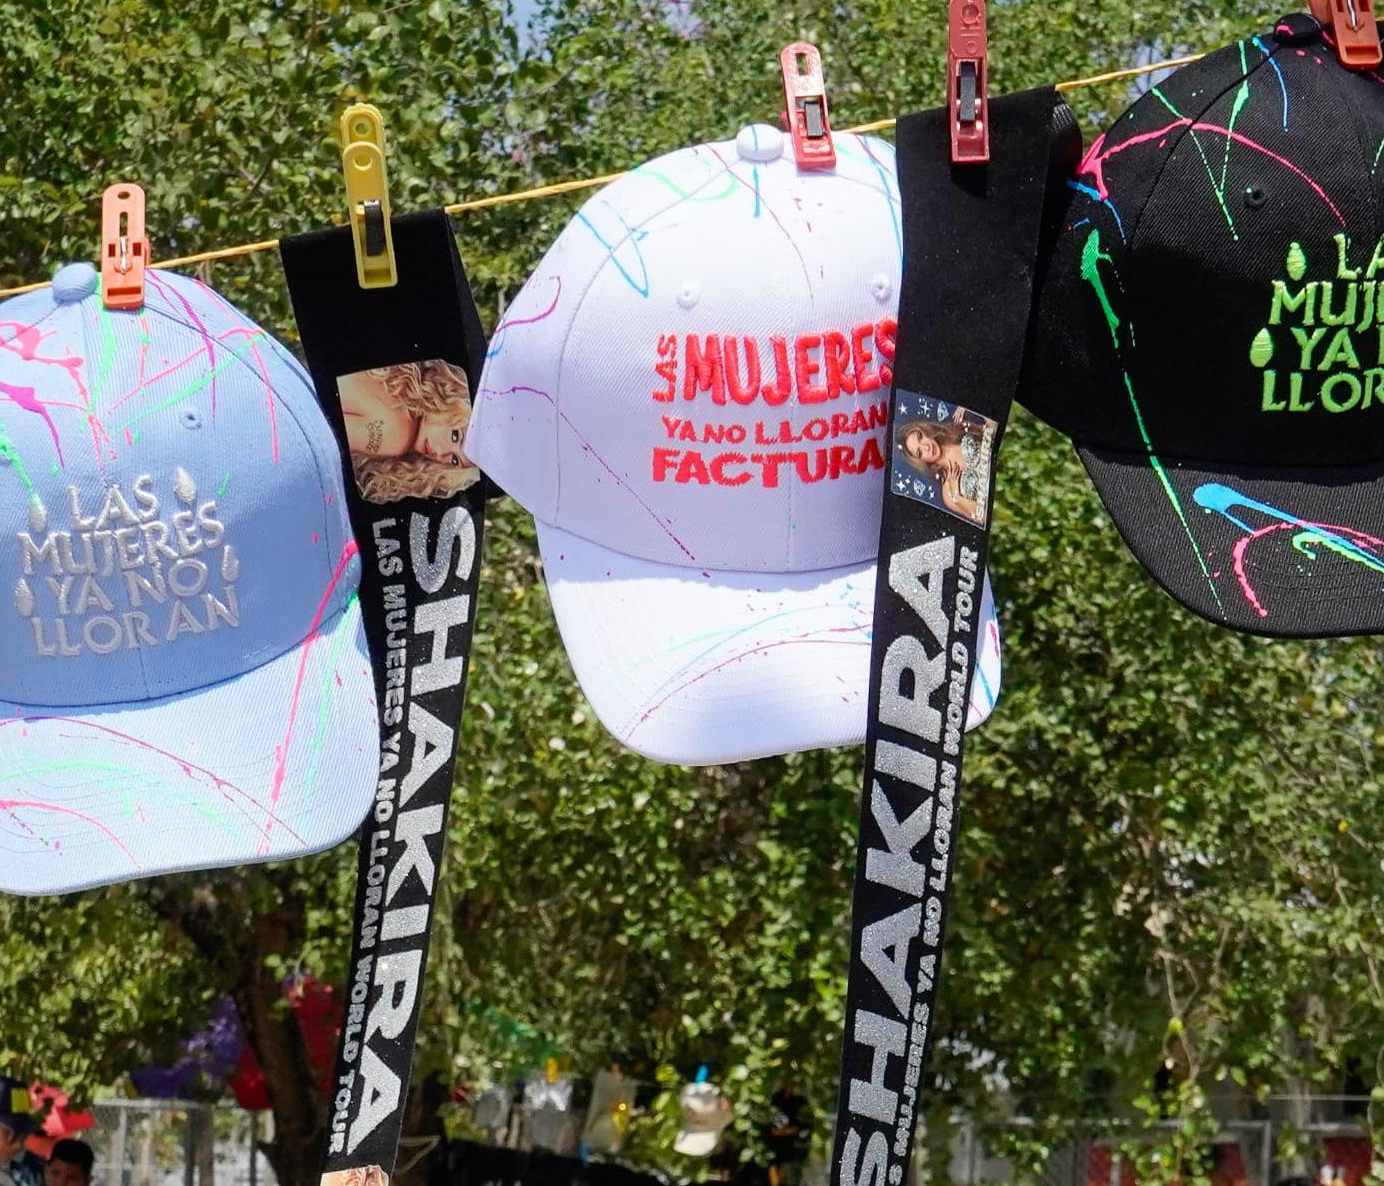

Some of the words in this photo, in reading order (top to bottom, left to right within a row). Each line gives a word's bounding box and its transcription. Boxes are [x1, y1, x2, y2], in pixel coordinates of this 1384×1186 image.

[650, 332, 678, 404] LAS
[682, 314, 899, 406] MUJERES
[1290, 326, 1361, 372] YA
[661, 413, 697, 443] YA
[703, 423, 747, 445] NO
[754, 400, 888, 446] LLORAN
[16, 500, 225, 577] MUJERES
[67, 473, 161, 530] LAS
[372, 517, 405, 578] LAS
[30, 584, 240, 657] LLORAN
[46, 575, 114, 615] YA
[123, 557, 208, 607] NO
[953, 545, 979, 633] TOUR
[382, 583, 408, 728] MUJERES
[943, 640, 969, 757] WORLD
[379, 731, 402, 773] YA
[346, 505, 476, 1156] SHAKIRA
[374, 777, 398, 824] NO
[929, 760, 957, 892] LLORAN
[359, 829, 391, 951] LLORAN
[923, 895, 942, 947] NO
[342, 953, 376, 1064] WORLD
[917, 953, 936, 995] YA
[327, 1068, 357, 1157] TOUR
[893, 1001, 930, 1158] MUJERES
